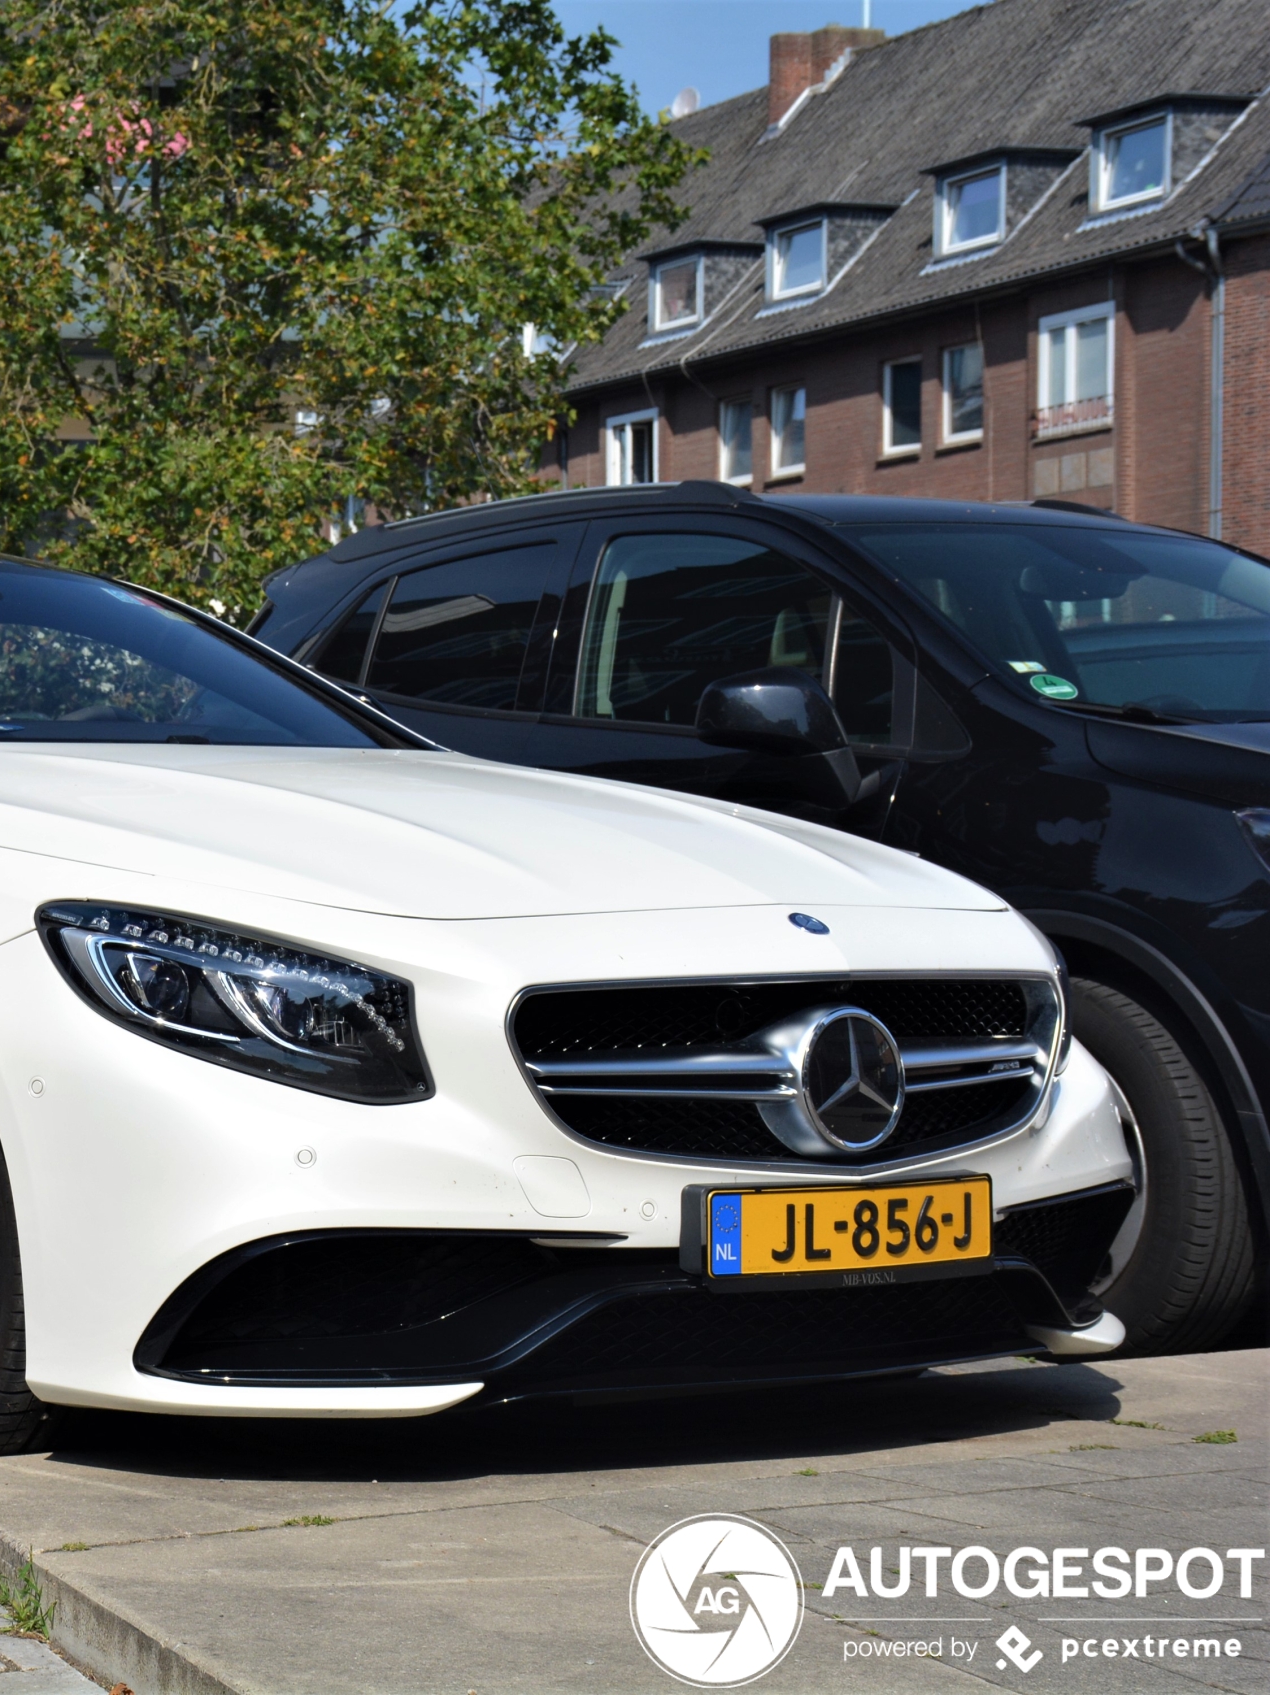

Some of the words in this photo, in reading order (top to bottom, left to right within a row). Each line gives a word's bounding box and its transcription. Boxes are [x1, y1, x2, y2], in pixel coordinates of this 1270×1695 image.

[771, 1192, 972, 1262] JL-856-J
[715, 1243, 737, 1261] NL
[842, 1271, 897, 1287] MB-VOS.NL
